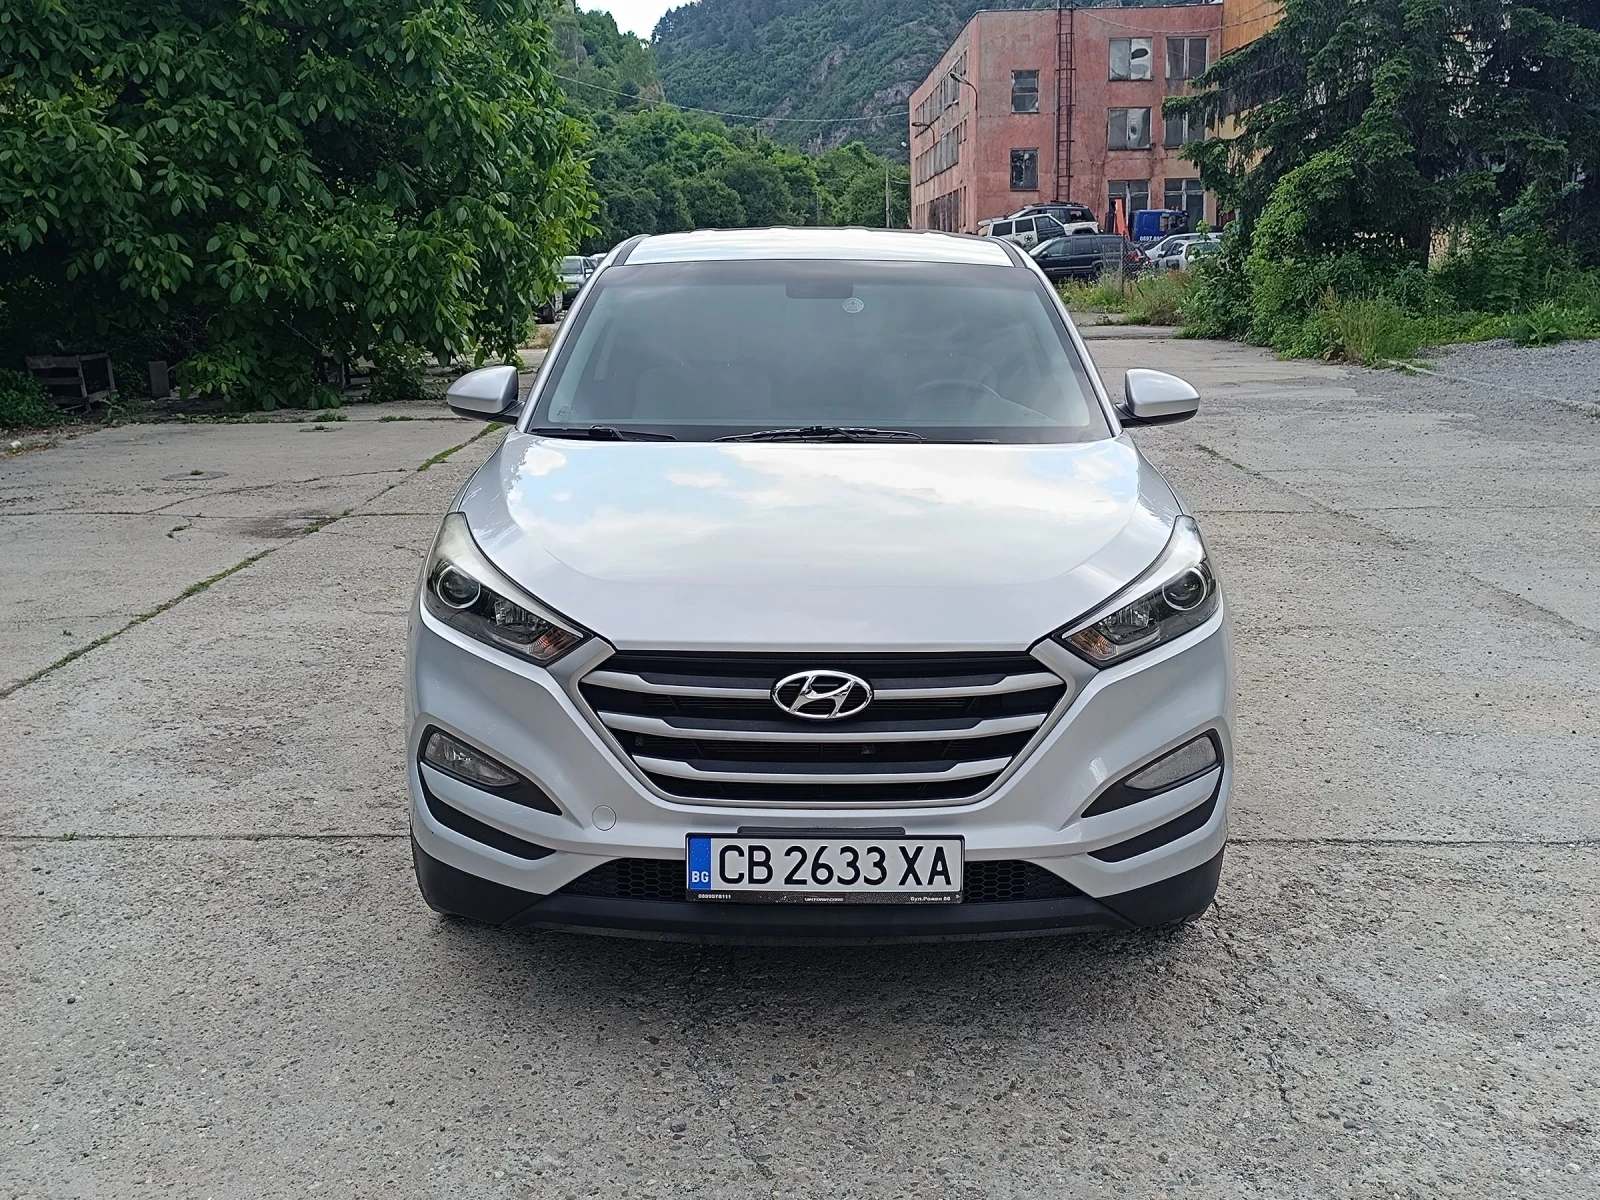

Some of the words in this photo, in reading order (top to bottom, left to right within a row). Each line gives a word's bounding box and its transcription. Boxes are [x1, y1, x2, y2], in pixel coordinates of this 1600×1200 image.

[691, 870, 709, 883] BG
[719, 844, 774, 884] CB
[784, 845, 887, 886] 2633
[898, 845, 952, 886] XA
